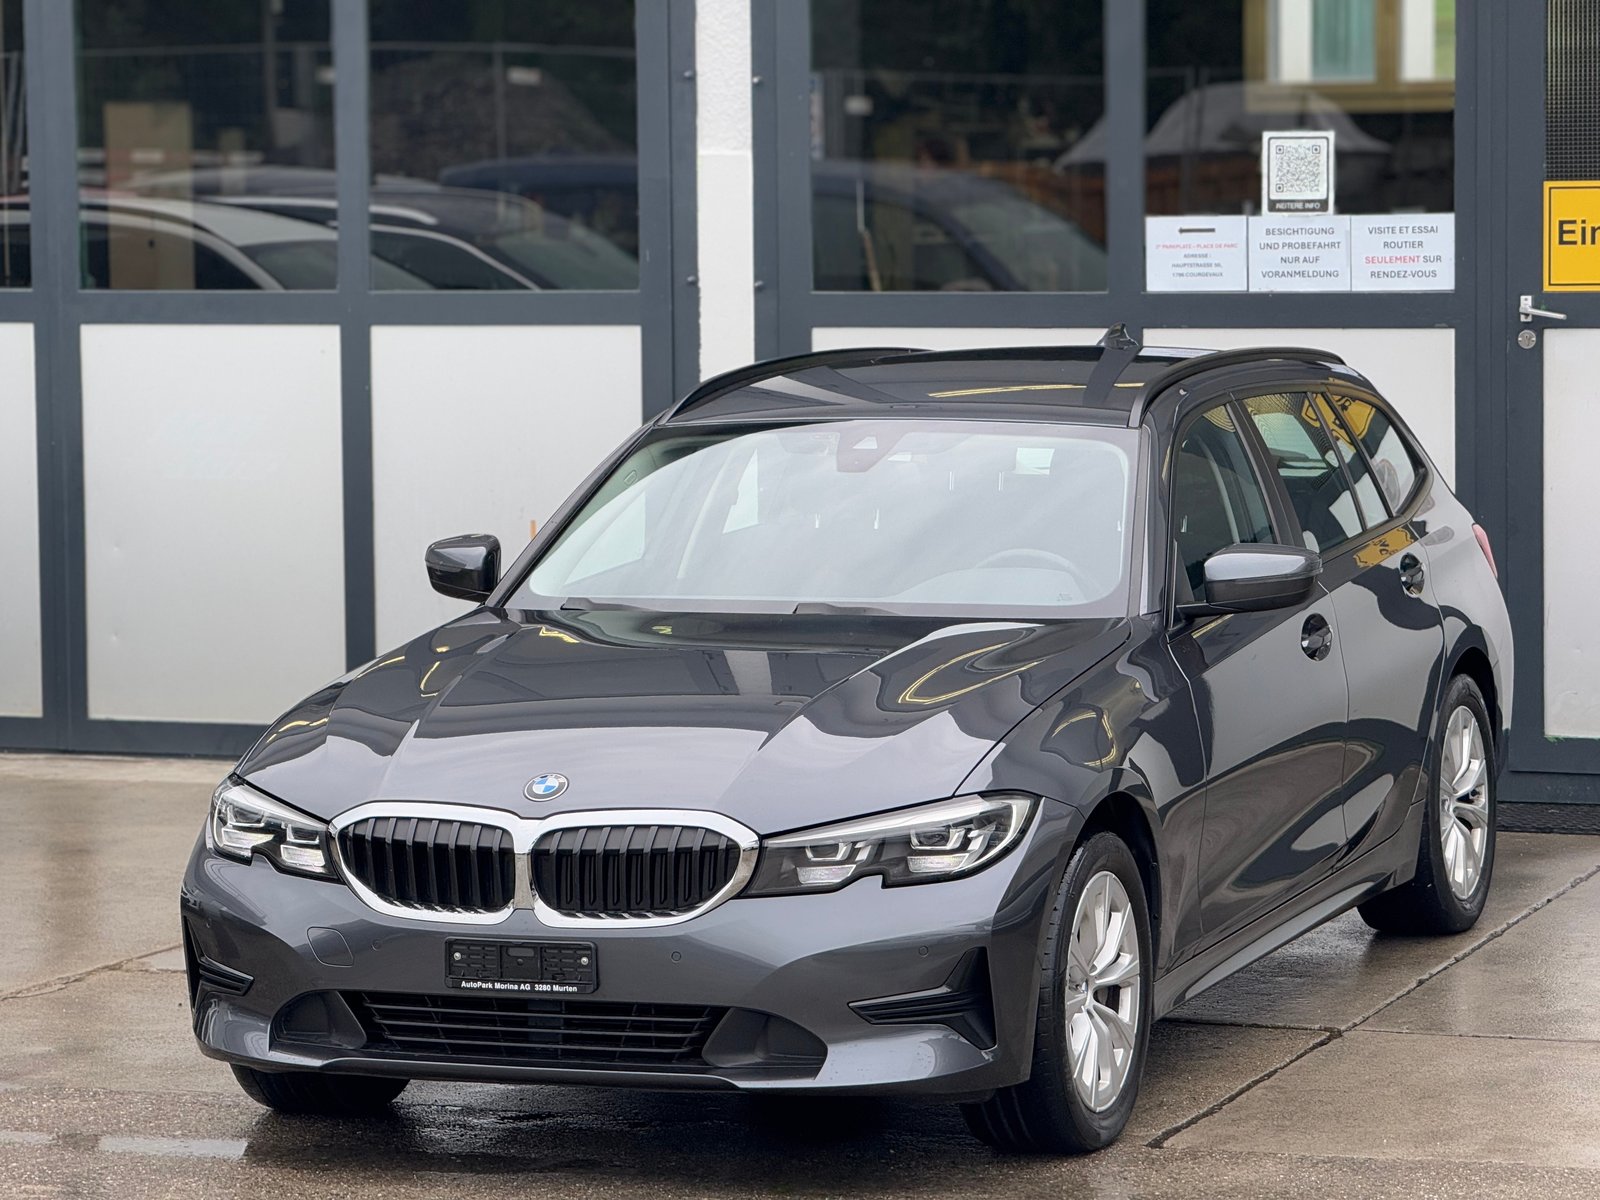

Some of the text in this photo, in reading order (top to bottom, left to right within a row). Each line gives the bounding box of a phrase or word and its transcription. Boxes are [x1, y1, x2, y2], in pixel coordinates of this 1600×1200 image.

[1265, 227, 1335, 236] BESICHTIGUNG
[1367, 225, 1438, 235] VISITE ET ESSAI
[1259, 241, 1341, 250] UND PROBEFAHRT
[1383, 241, 1424, 249] ROUTIER
[1280, 255, 1320, 264] NUR AUF
[1365, 255, 1442, 264] SEULEMENT SUR
[1261, 270, 1339, 278] VORANMELDUNG
[1370, 270, 1437, 278] RENDEZ-VOUS
[461, 981, 493, 989] AutoPark
[494, 982, 519, 990] Morina
[552, 984, 578, 992] Murten
